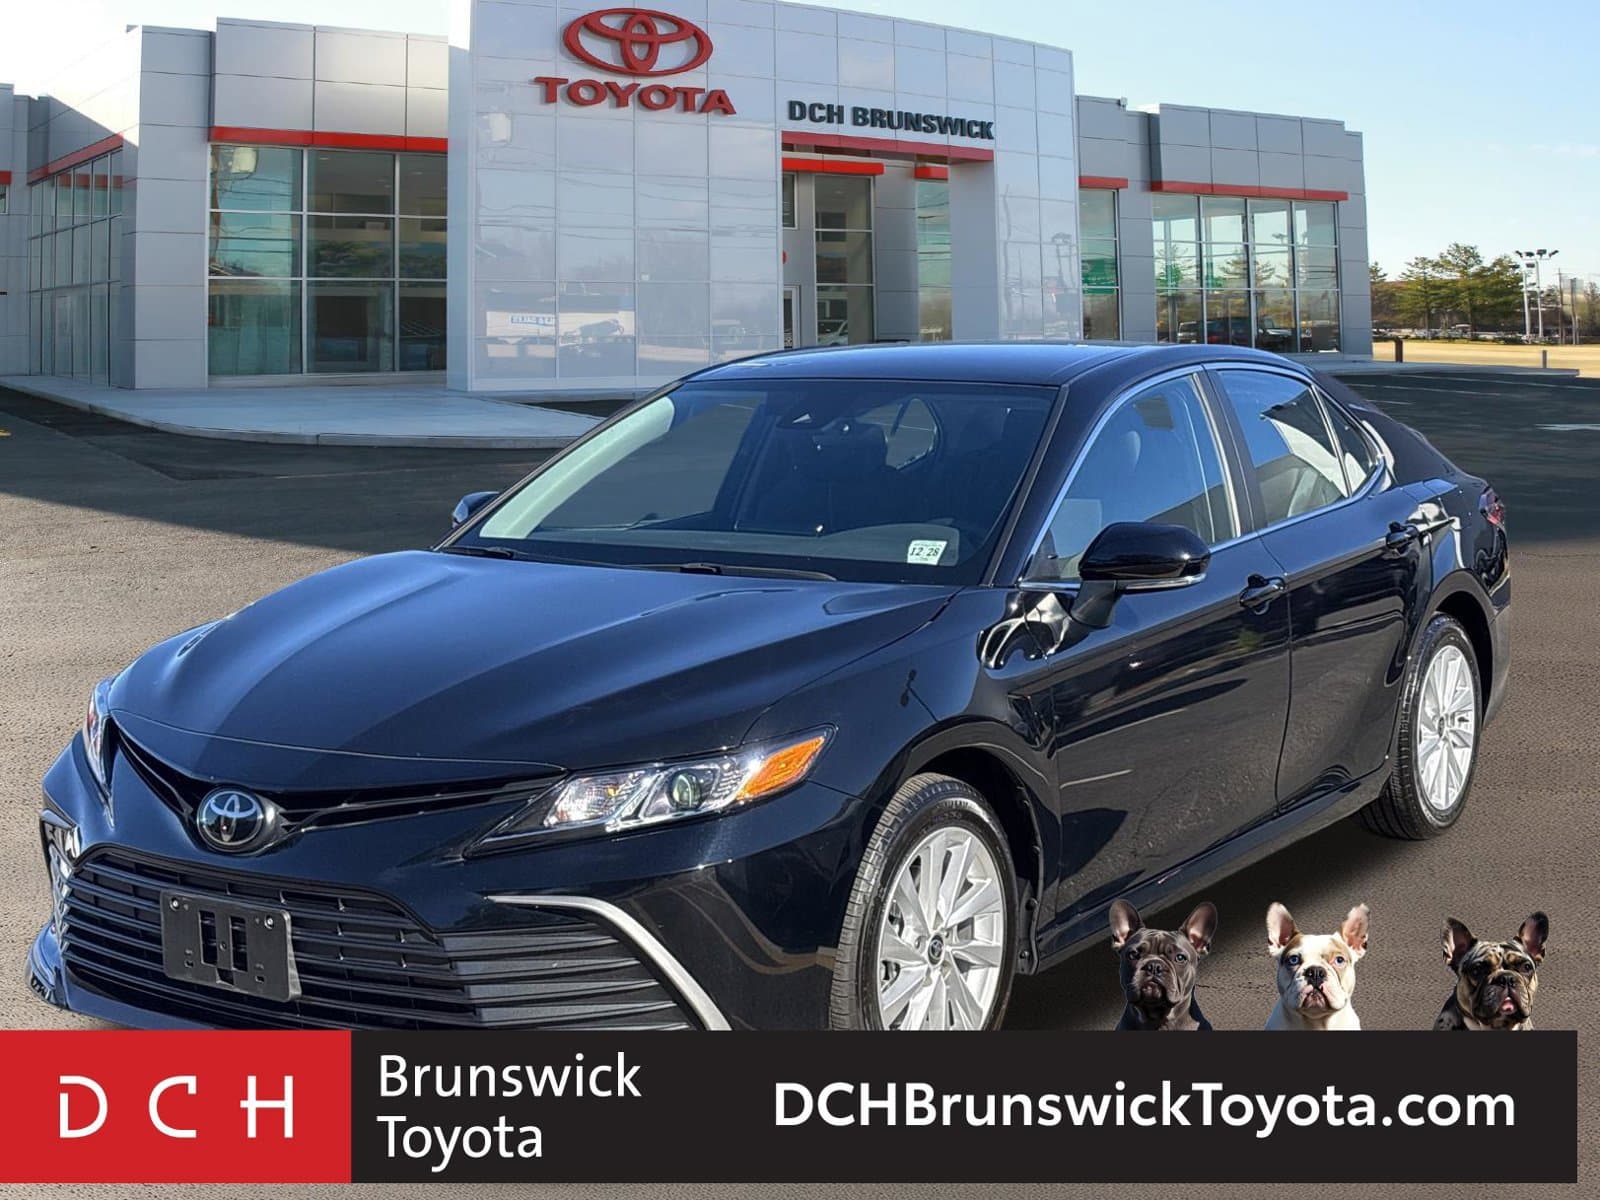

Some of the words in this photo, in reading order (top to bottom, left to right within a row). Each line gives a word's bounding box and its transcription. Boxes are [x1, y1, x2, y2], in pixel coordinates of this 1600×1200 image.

[534, 76, 736, 115] TOYOTA
[788, 100, 844, 125] DCH
[852, 106, 995, 140] BRUNSWICK
